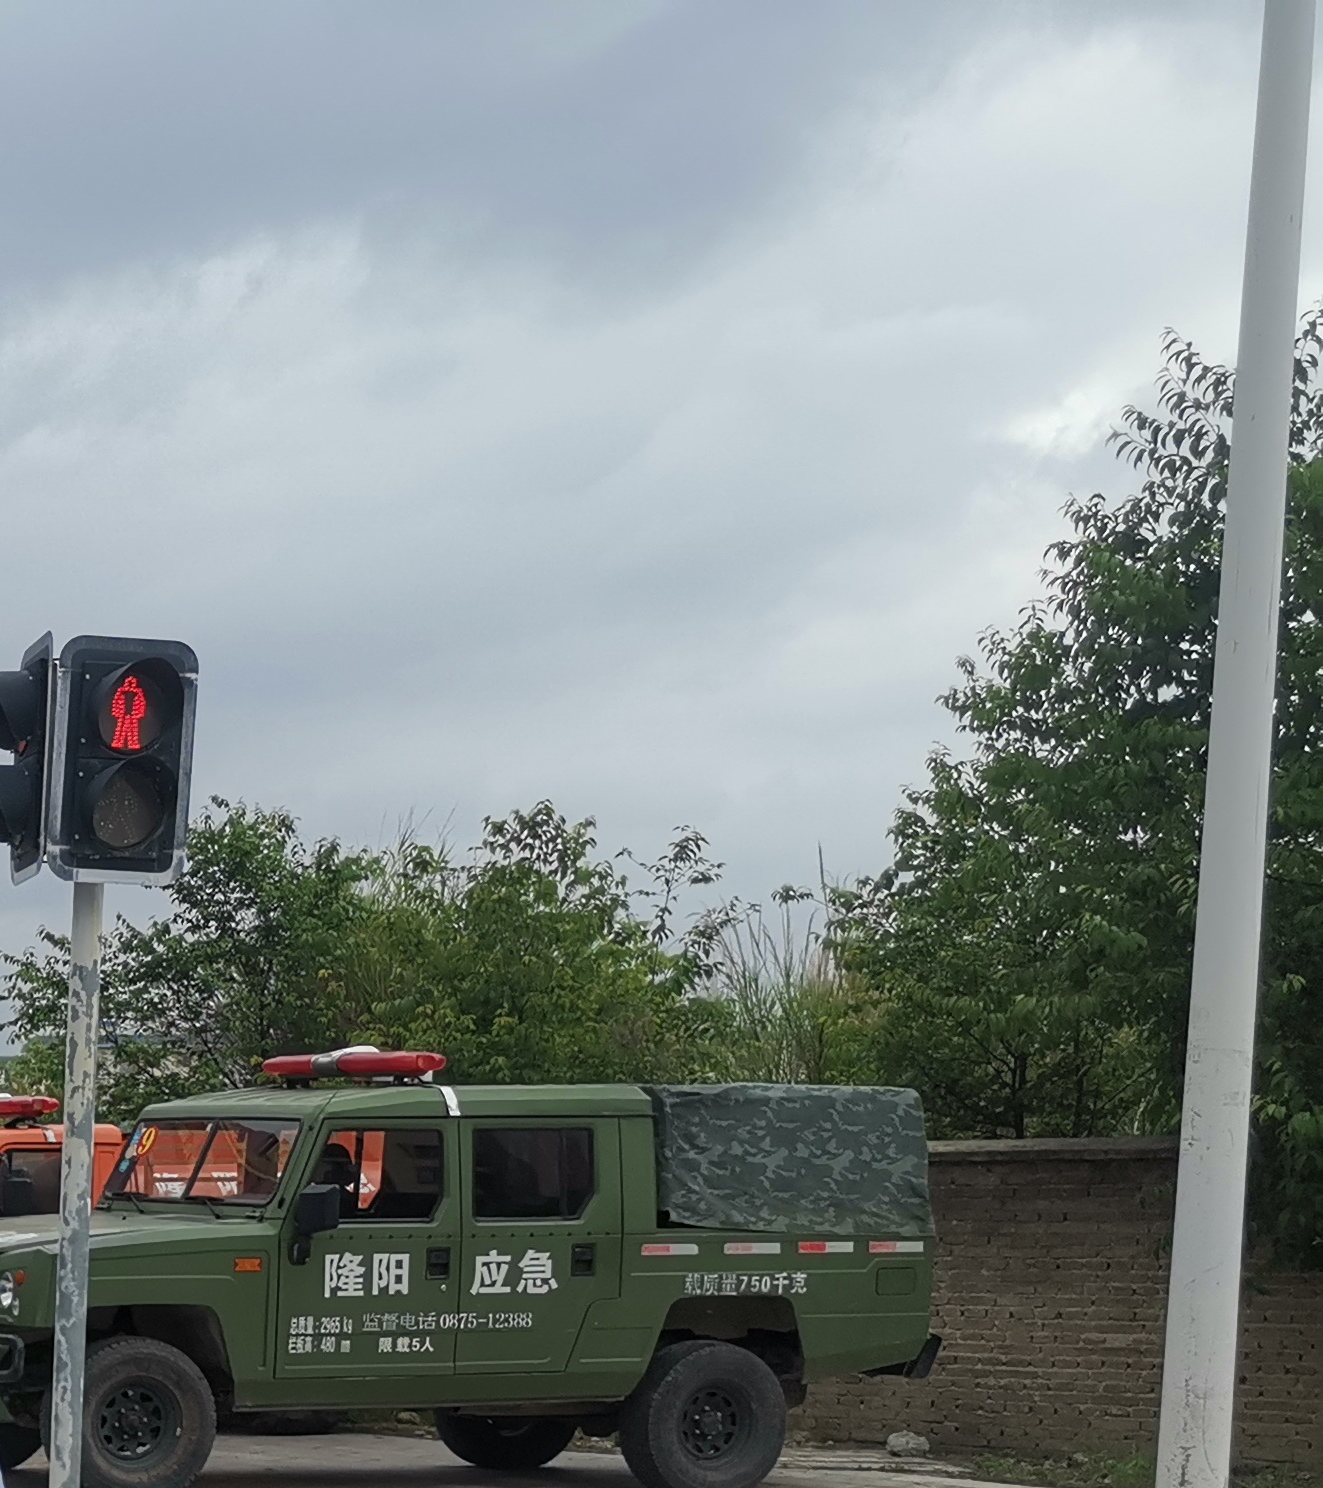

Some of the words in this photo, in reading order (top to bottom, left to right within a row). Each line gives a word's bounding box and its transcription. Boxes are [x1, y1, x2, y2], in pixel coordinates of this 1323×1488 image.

[138, 1127, 157, 1155] 9
[323, 1251, 411, 1299] 隆阳
[469, 1249, 559, 1296] 应急
[683, 1271, 808, 1296] 载质量750千克
